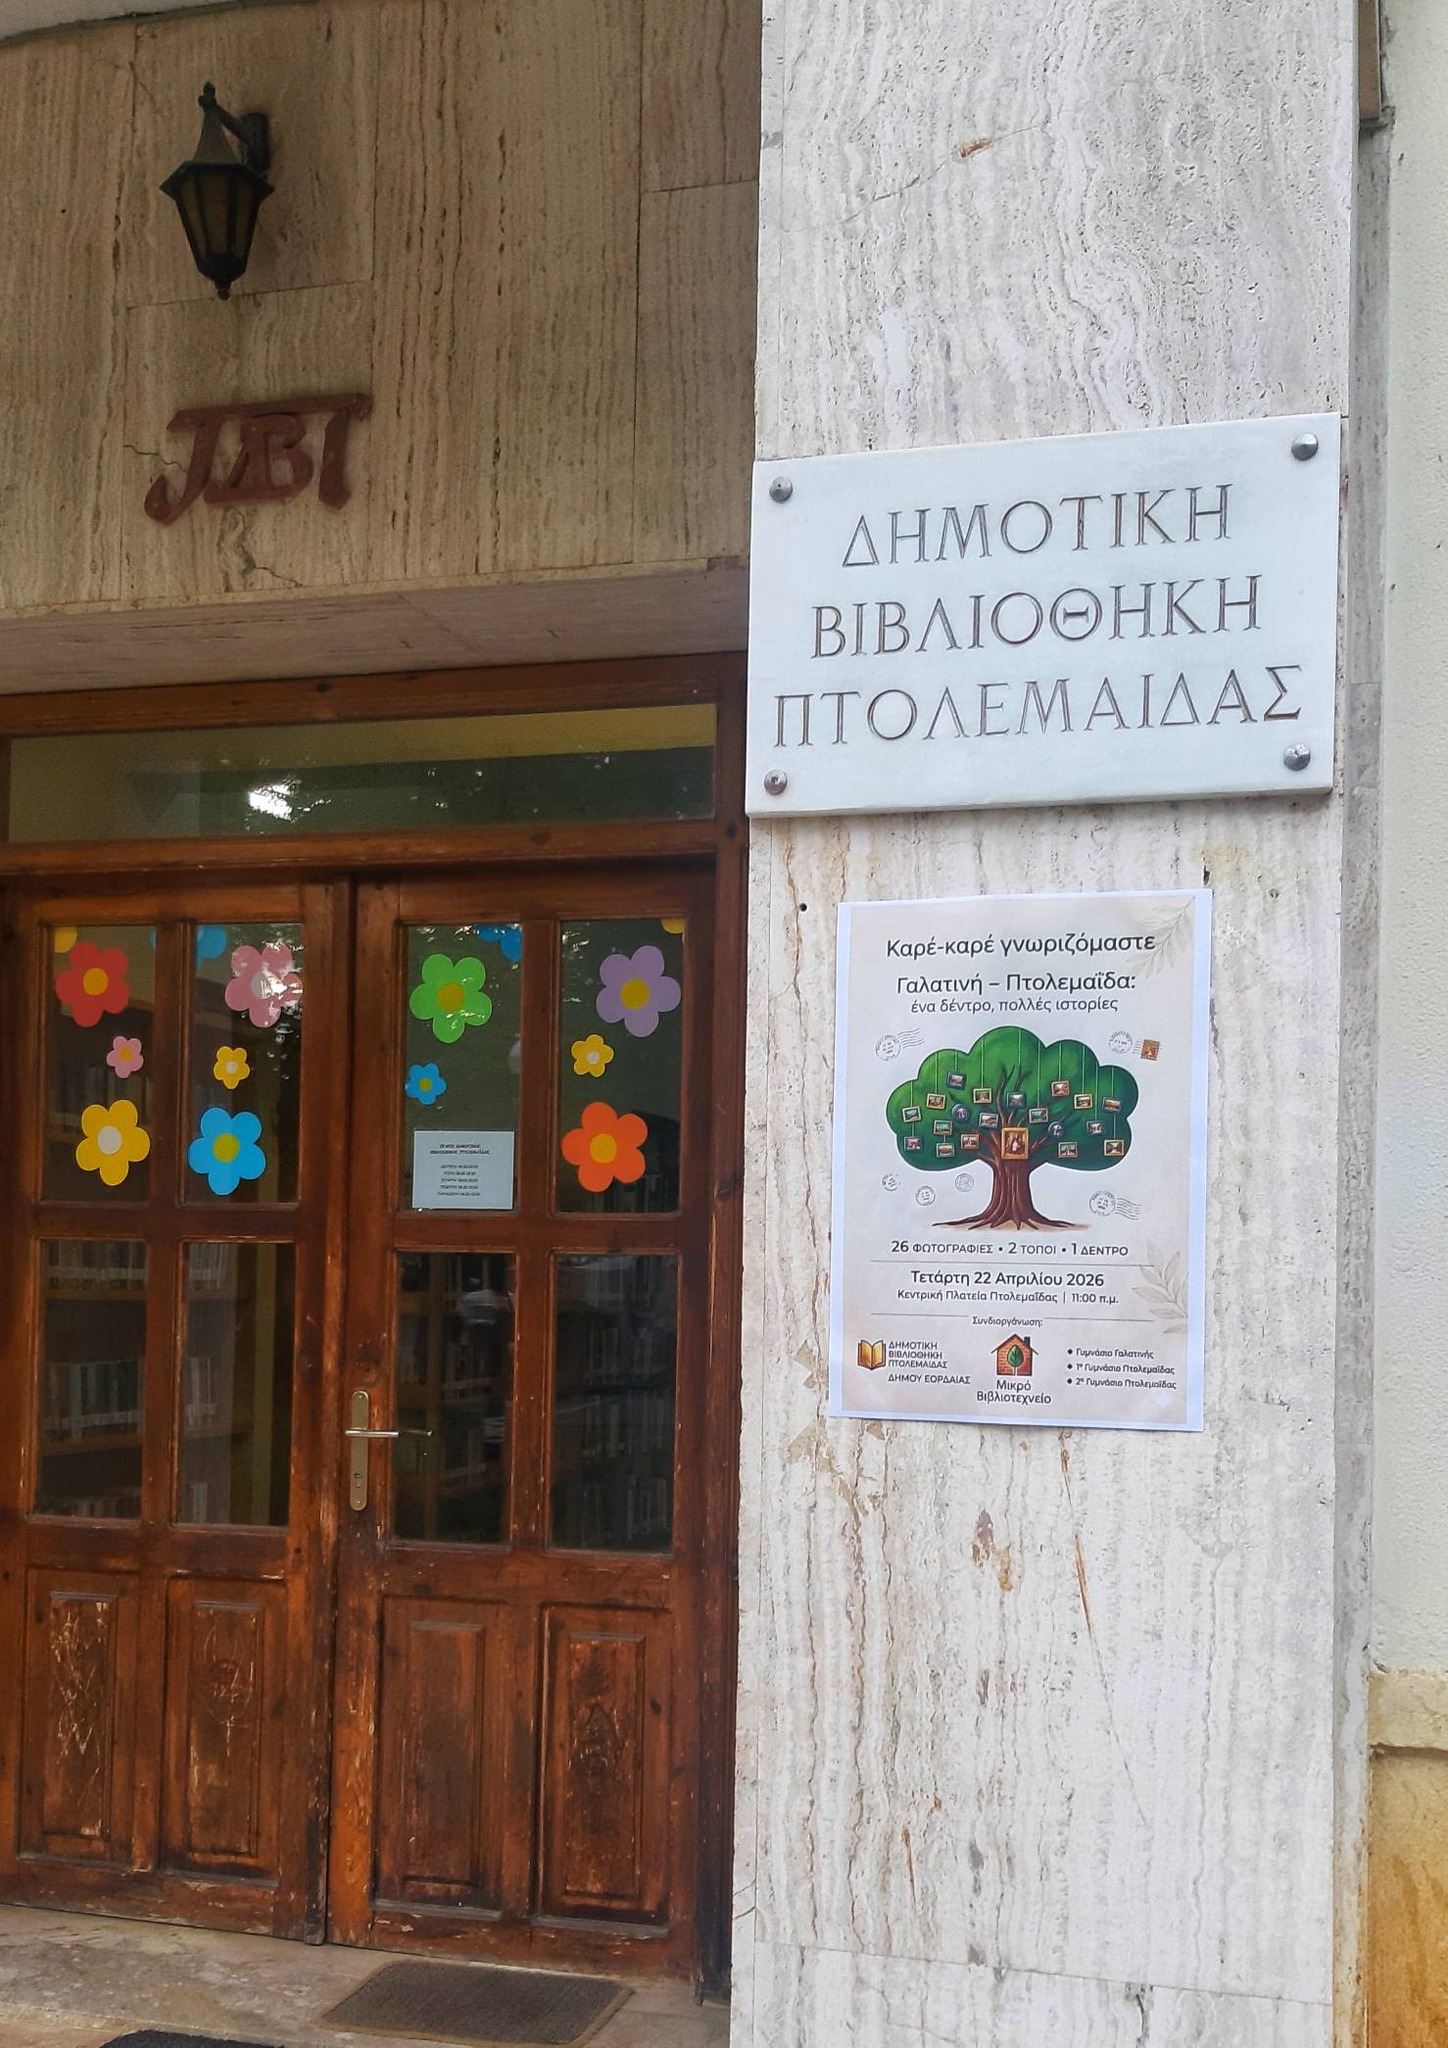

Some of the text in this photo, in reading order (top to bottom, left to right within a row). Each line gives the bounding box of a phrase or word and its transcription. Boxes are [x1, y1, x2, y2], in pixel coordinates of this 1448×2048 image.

[842, 484, 1233, 567] ΔΗΜΟΤΙΚΗ
[810, 574, 1262, 659] ΒΙΒΛΙΟΘΗΚΗ
[773, 664, 1301, 748] ΠΤΟΛΕΜΑΙΔΑΣ
[886, 932, 1156, 960] Καρέ-καρέ γνωριζόμαστε
[897, 973, 982, 996] Γαλατινή
[1006, 971, 1136, 994] Πτολεμαΐδα:
[911, 996, 1119, 1014] ένα δέντρο, πολλές ιστορίες
[891, 1240, 909, 1253] 26
[912, 1243, 994, 1254] ΦΩΤΟΓΡΑΦΙΕΣ
[1008, 1242, 1017, 1254] 2
[1020, 1245, 1057, 1255] ΤΟΠΟΙ
[1080, 1246, 1129, 1256] ΔΕΝΤΡΟ
[911, 1270, 1105, 1288] Τετάρτη 22 Απριλίου 2026
[897, 1289, 943, 1301] Κεντρική
[946, 1290, 988, 1301] Πλατεία
[1071, 1293, 1097, 1303] 11:00
[1099, 1295, 1119, 1305] π.μ.
[972, 1316, 1043, 1328] Συνδιοργάνωση:
[889, 1341, 938, 1350] ΔΗΜΟΤΙΚΗ
[889, 1350, 943, 1360] ΒΙΒΛΙΟΘΗΚΗ
[1076, 1348, 1113, 1358] Γυμνάσιο
[888, 1359, 948, 1369] ΠΤΟΛΕΜΑΙΔΑΣ
[1085, 1363, 1121, 1373] Γυμνάσιο
[888, 1373, 971, 1385] ΔΗΜΟΥ ΕΟΡΔΑΙΑΣ
[1086, 1378, 1123, 1388] Γυμνάσιο
[996, 1380, 1032, 1393] Μικρό
[976, 1391, 1052, 1405] Βιβλιοτεχνείο
